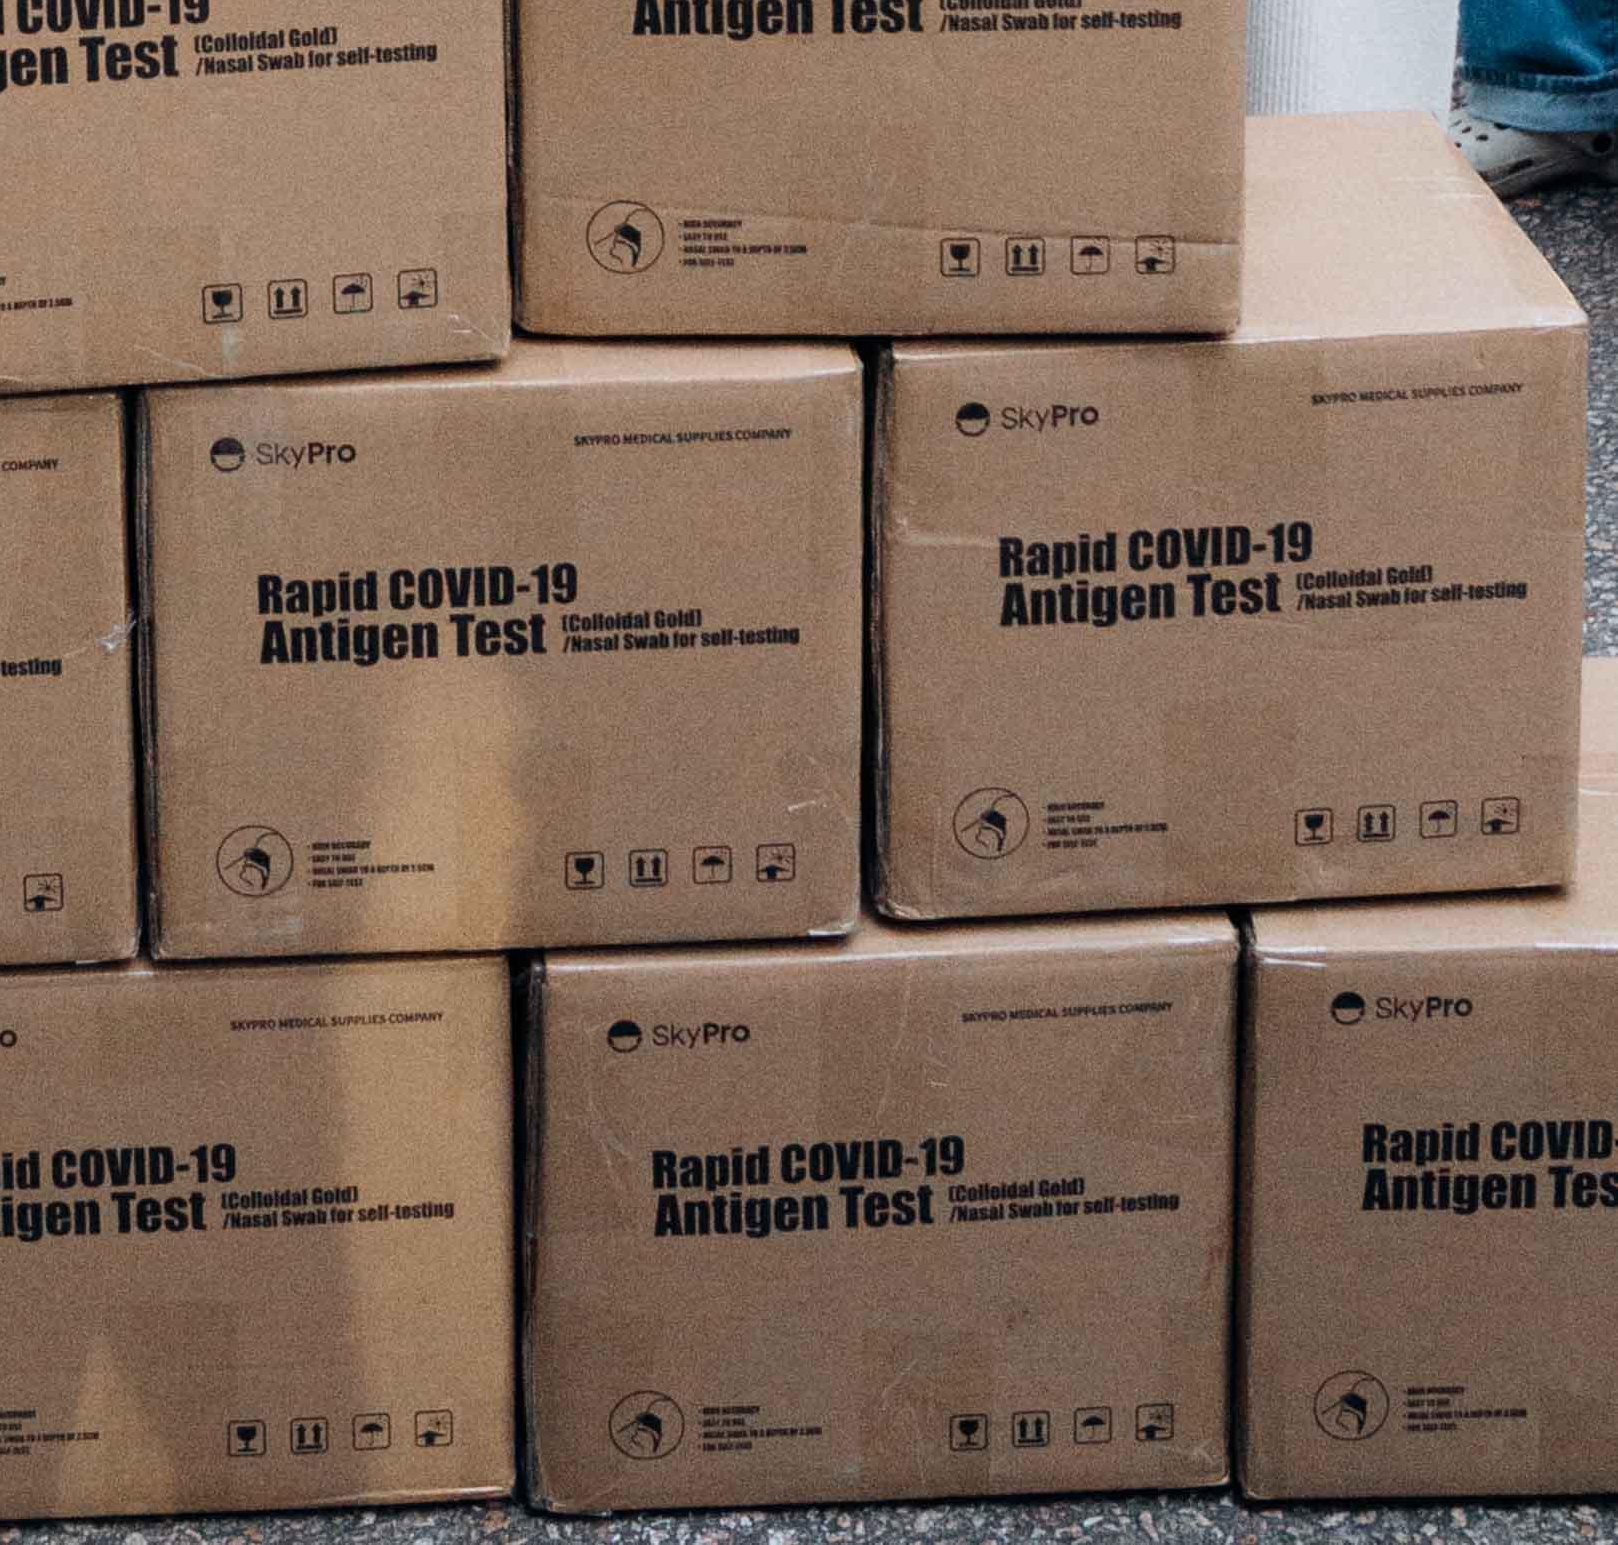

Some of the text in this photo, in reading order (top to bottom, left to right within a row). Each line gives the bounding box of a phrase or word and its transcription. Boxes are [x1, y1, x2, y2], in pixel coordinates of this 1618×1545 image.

[79, 35, 180, 82] Test
[255, 51, 305, 72] Swab
[308, 51, 332, 69] for
[1000, 405, 1099, 433] SkyPro
[255, 441, 356, 469] SkyPro
[1000, 521, 1315, 579] Rapid COVID-19
[256, 563, 579, 617] Rapid COVID-19
[999, 572, 1282, 627] Antigen Test
[258, 613, 548, 667] Antigen Test
[621, 632, 671, 651] Swab
[674, 632, 697, 650] for
[1375, 996, 1473, 1023] SkyPro
[652, 1023, 750, 1050] SkyPro
[51, 1143, 237, 1188] COVID-19
[654, 1136, 965, 1191] Rapid COVID-19
[1363, 1120, 1618, 1167] Rapid COVID
[111, 1191, 207, 1233] Test
[653, 1185, 934, 1238] Antigen Test
[1361, 1168, 1537, 1216] Antigen
[279, 1208, 328, 1227] Swab
[331, 1209, 354, 1225] for
